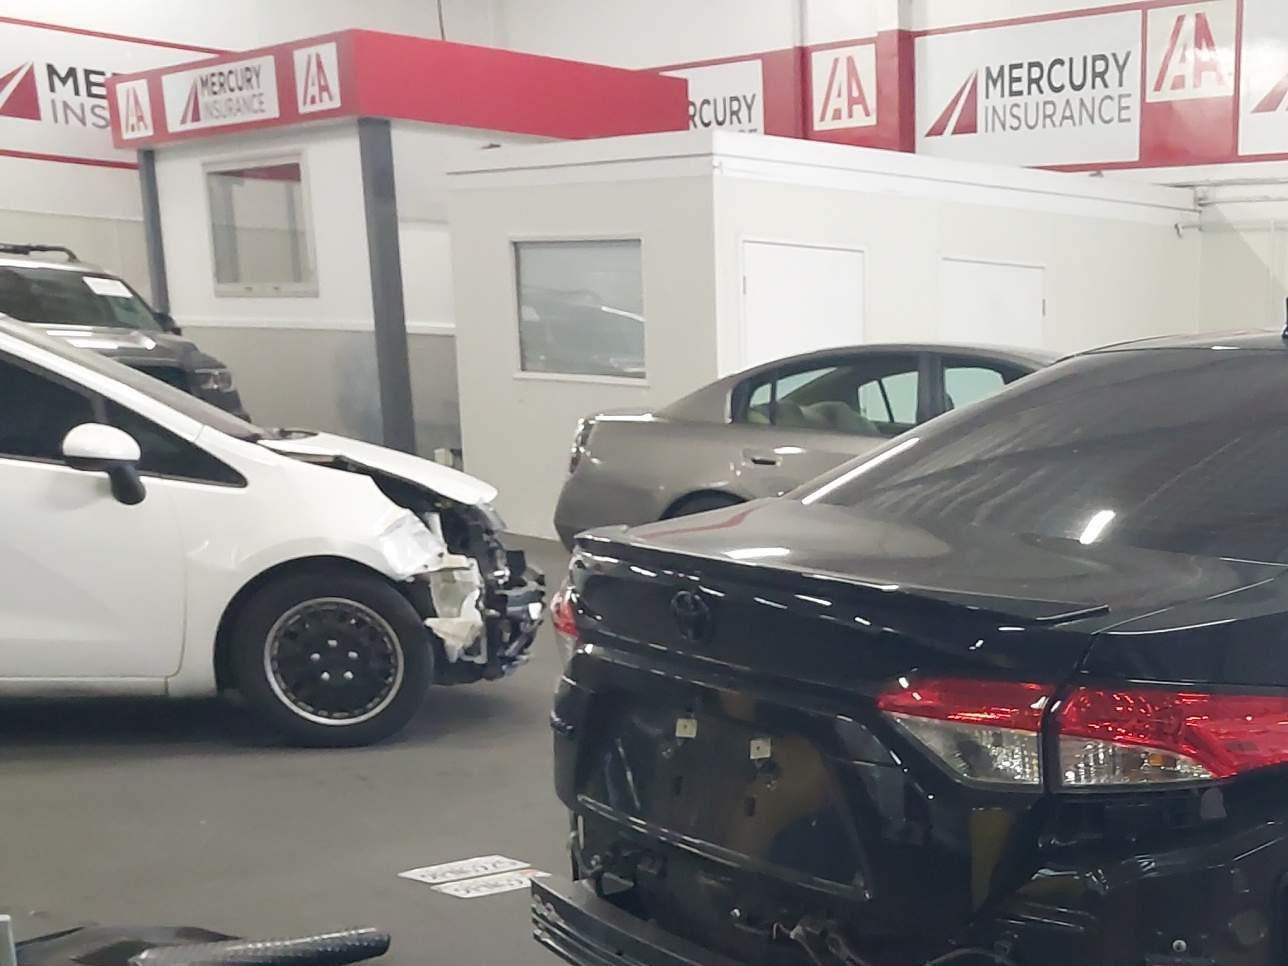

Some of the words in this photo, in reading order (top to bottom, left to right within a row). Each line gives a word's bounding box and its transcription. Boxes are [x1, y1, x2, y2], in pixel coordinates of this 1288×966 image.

[46, 63, 108, 99] ME
[200, 64, 262, 97] MERCURY
[984, 50, 1132, 99] MERCURY
[984, 93, 1132, 133] INSURANCE
